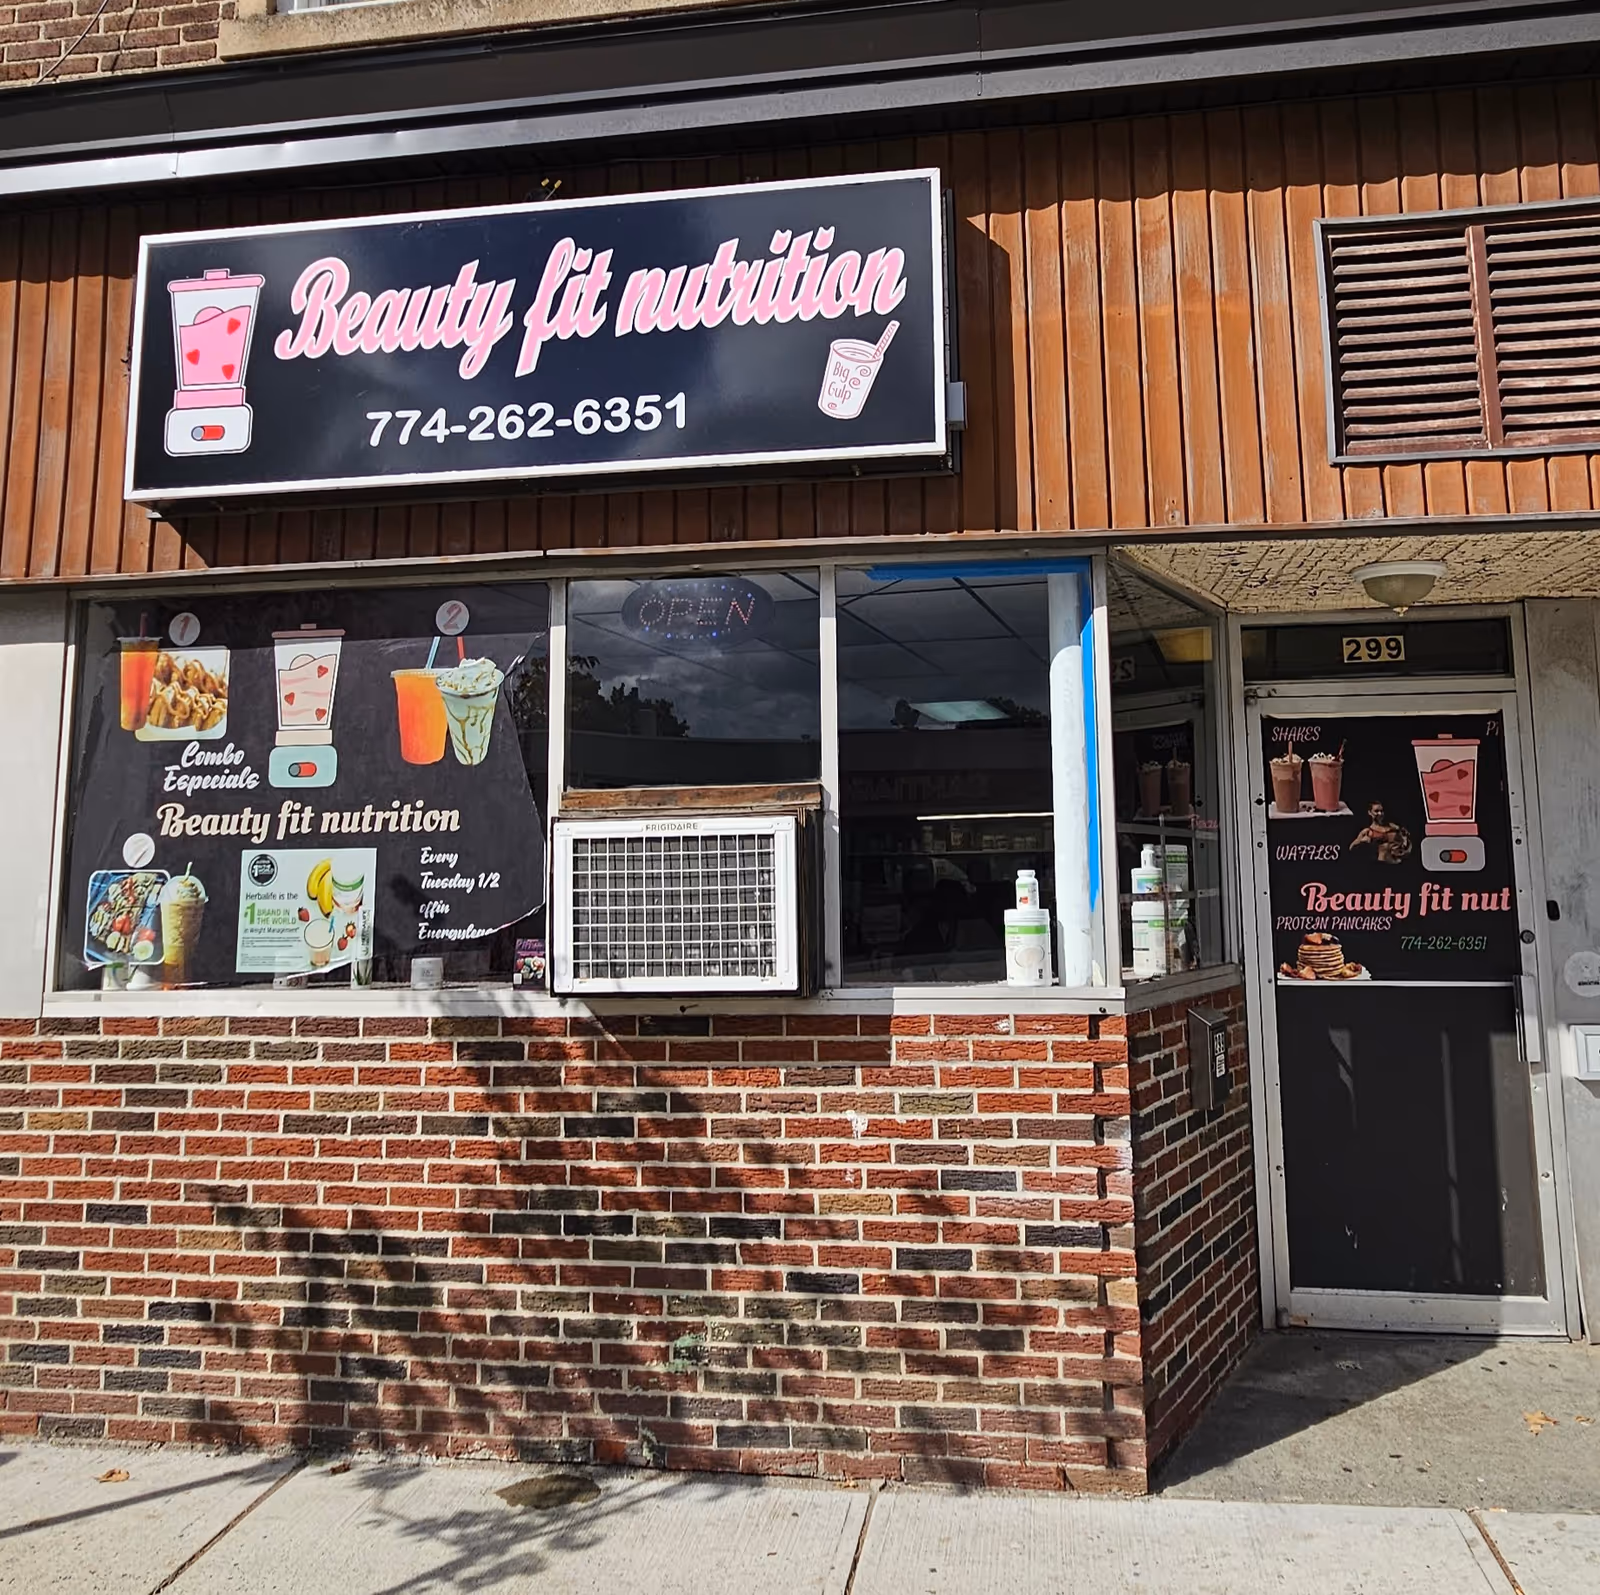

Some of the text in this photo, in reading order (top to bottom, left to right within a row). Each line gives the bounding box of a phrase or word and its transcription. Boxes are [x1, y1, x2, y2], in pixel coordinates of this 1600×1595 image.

[274, 226, 907, 380] Beauty fit nutrition
[833, 361, 850, 383] Big
[828, 381, 852, 405] Gulp
[366, 392, 686, 447] 774-262-6351
[639, 594, 756, 626] OPEN
[1345, 637, 1402, 661] 299
[1272, 726, 1321, 742] SHAKES
[181, 741, 245, 768] Combo
[163, 764, 261, 797] Especials
[156, 800, 460, 844] Beauty fit nutrition
[645, 822, 699, 831] FRIGIDAIRE
[420, 846, 458, 869] Every
[1276, 844, 1341, 861] WAFFLES
[420, 871, 501, 894] Tuesday 1/2
[245, 892, 277, 901] Herbalife
[287, 892, 299, 901] the
[1301, 882, 1511, 919] Beauty fit nut
[257, 908, 281, 917] BRAND
[257, 917, 297, 925] THE WORLD
[1276, 916, 1393, 931] PROTEIN PANCAKES
[1400, 936, 1487, 950] 774-262-6351
